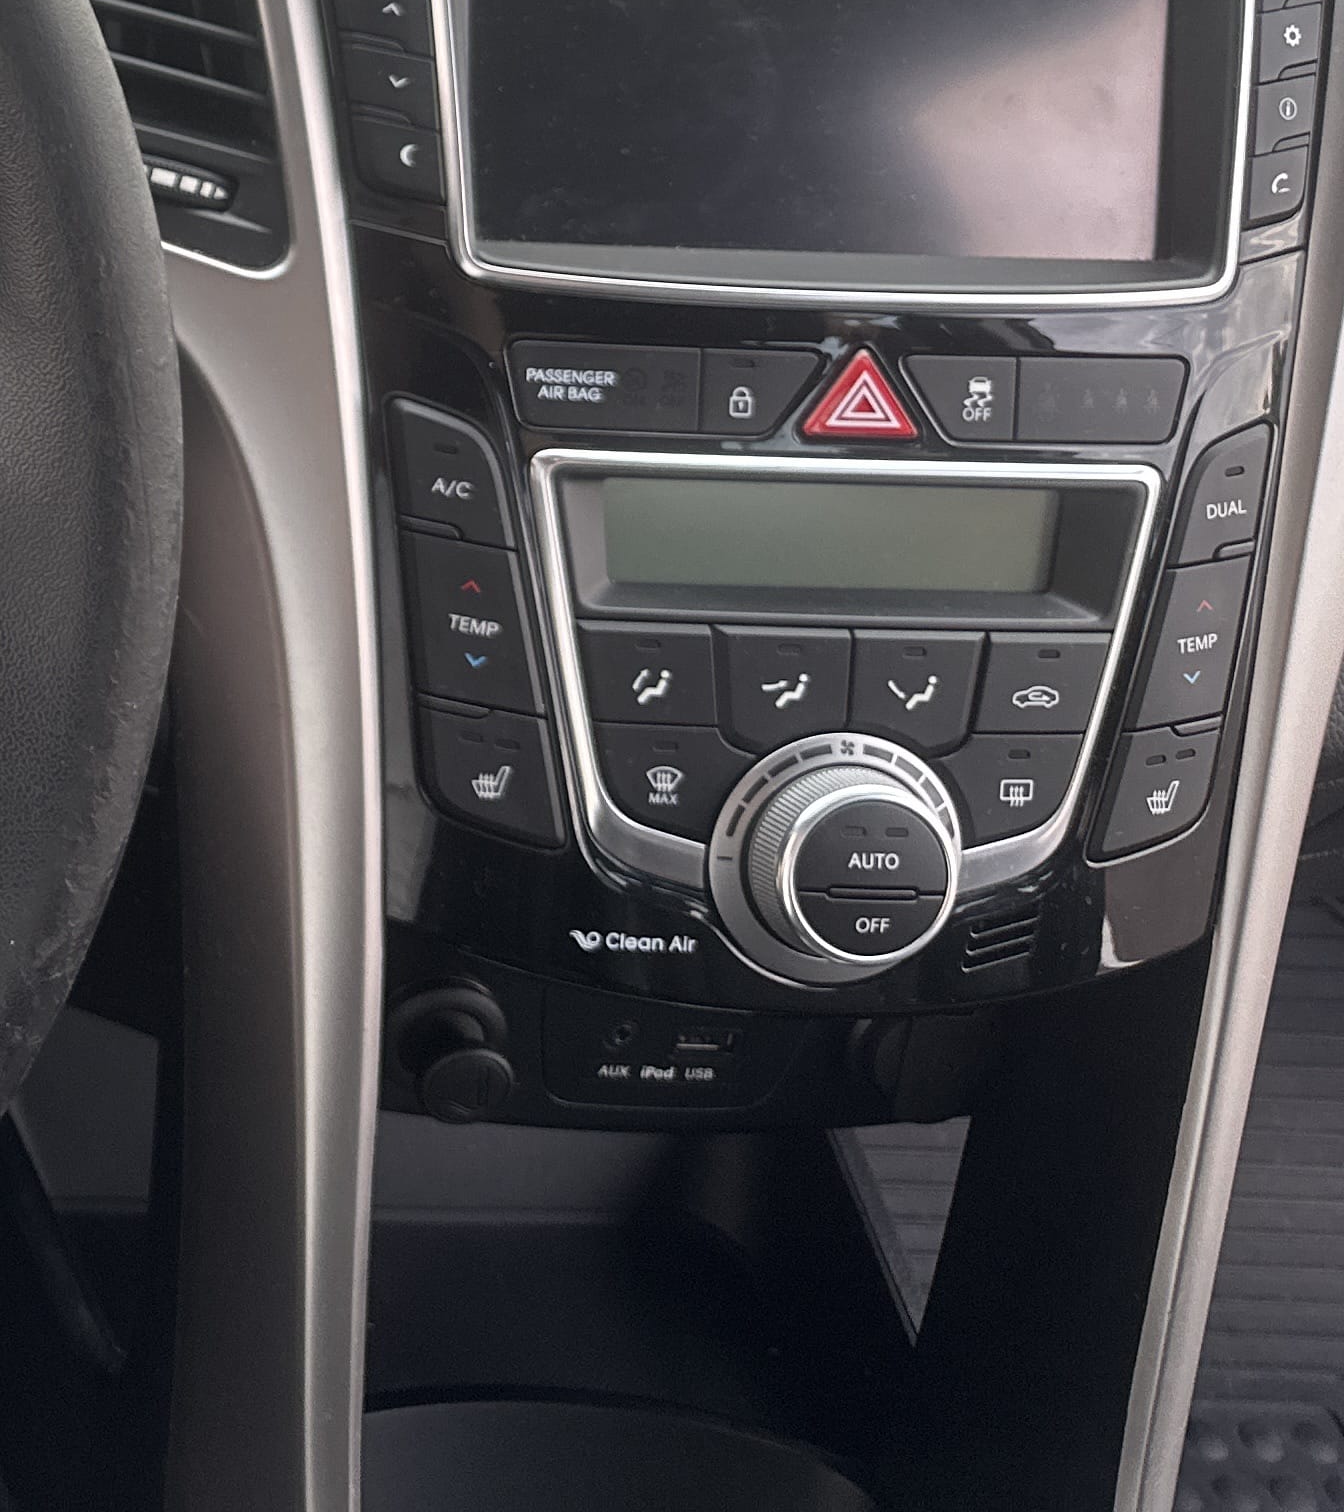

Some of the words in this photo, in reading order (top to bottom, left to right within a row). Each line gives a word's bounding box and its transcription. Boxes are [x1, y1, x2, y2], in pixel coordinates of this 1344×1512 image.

[525, 367, 617, 387] PASSENGER
[538, 385, 566, 401] AIR
[568, 386, 604, 403] BAG
[962, 406, 992, 422] OFF
[431, 477, 474, 499] A/C
[1206, 500, 1247, 519] DUAL
[448, 613, 502, 638] TEMP
[1177, 633, 1218, 655] TEMP
[648, 791, 680, 805] MAX
[848, 852, 900, 871] AUTO
[855, 917, 890, 935] OFF
[605, 931, 665, 952] Clean
[668, 934, 698, 953] Air
[597, 1064, 631, 1080] AUX
[640, 1065, 675, 1081] iPod
[684, 1067, 715, 1082] USB
